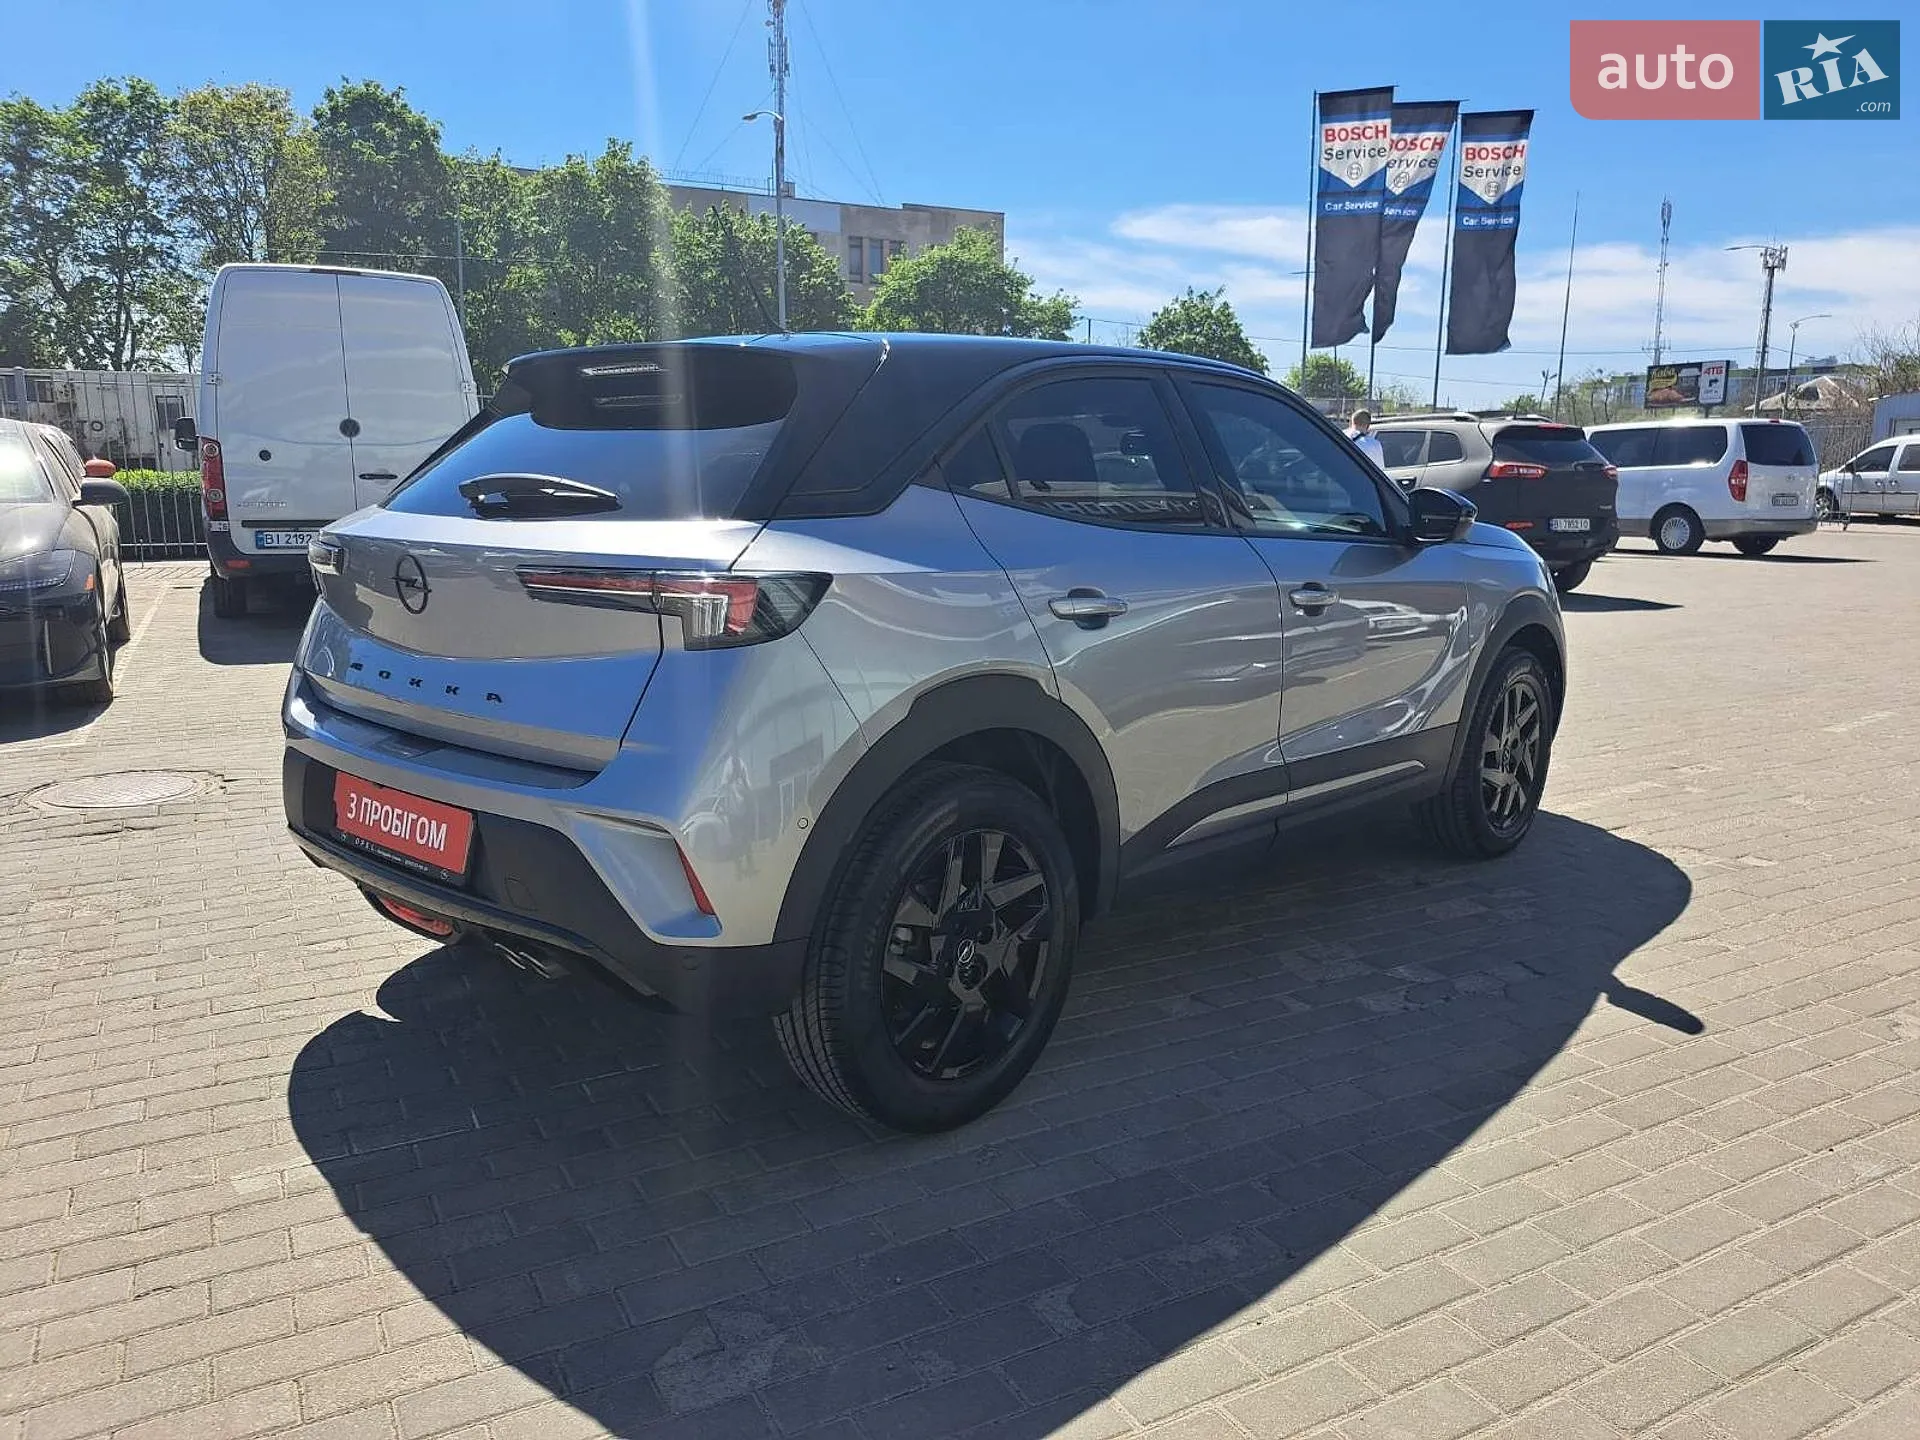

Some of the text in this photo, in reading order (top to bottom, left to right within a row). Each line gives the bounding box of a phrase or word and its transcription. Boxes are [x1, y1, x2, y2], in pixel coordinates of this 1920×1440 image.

[1324, 125, 1388, 143] BOSCH
[1323, 145, 1387, 161] Service
[1465, 144, 1525, 160] BOSCH
[1386, 156, 1438, 169] ervice
[1463, 164, 1521, 178] Service
[1325, 200, 1379, 211] Car Service
[1463, 215, 1514, 226] Car Service
[265, 533, 280, 545] BI
[359, 797, 448, 852] ПРОБІГОМ
